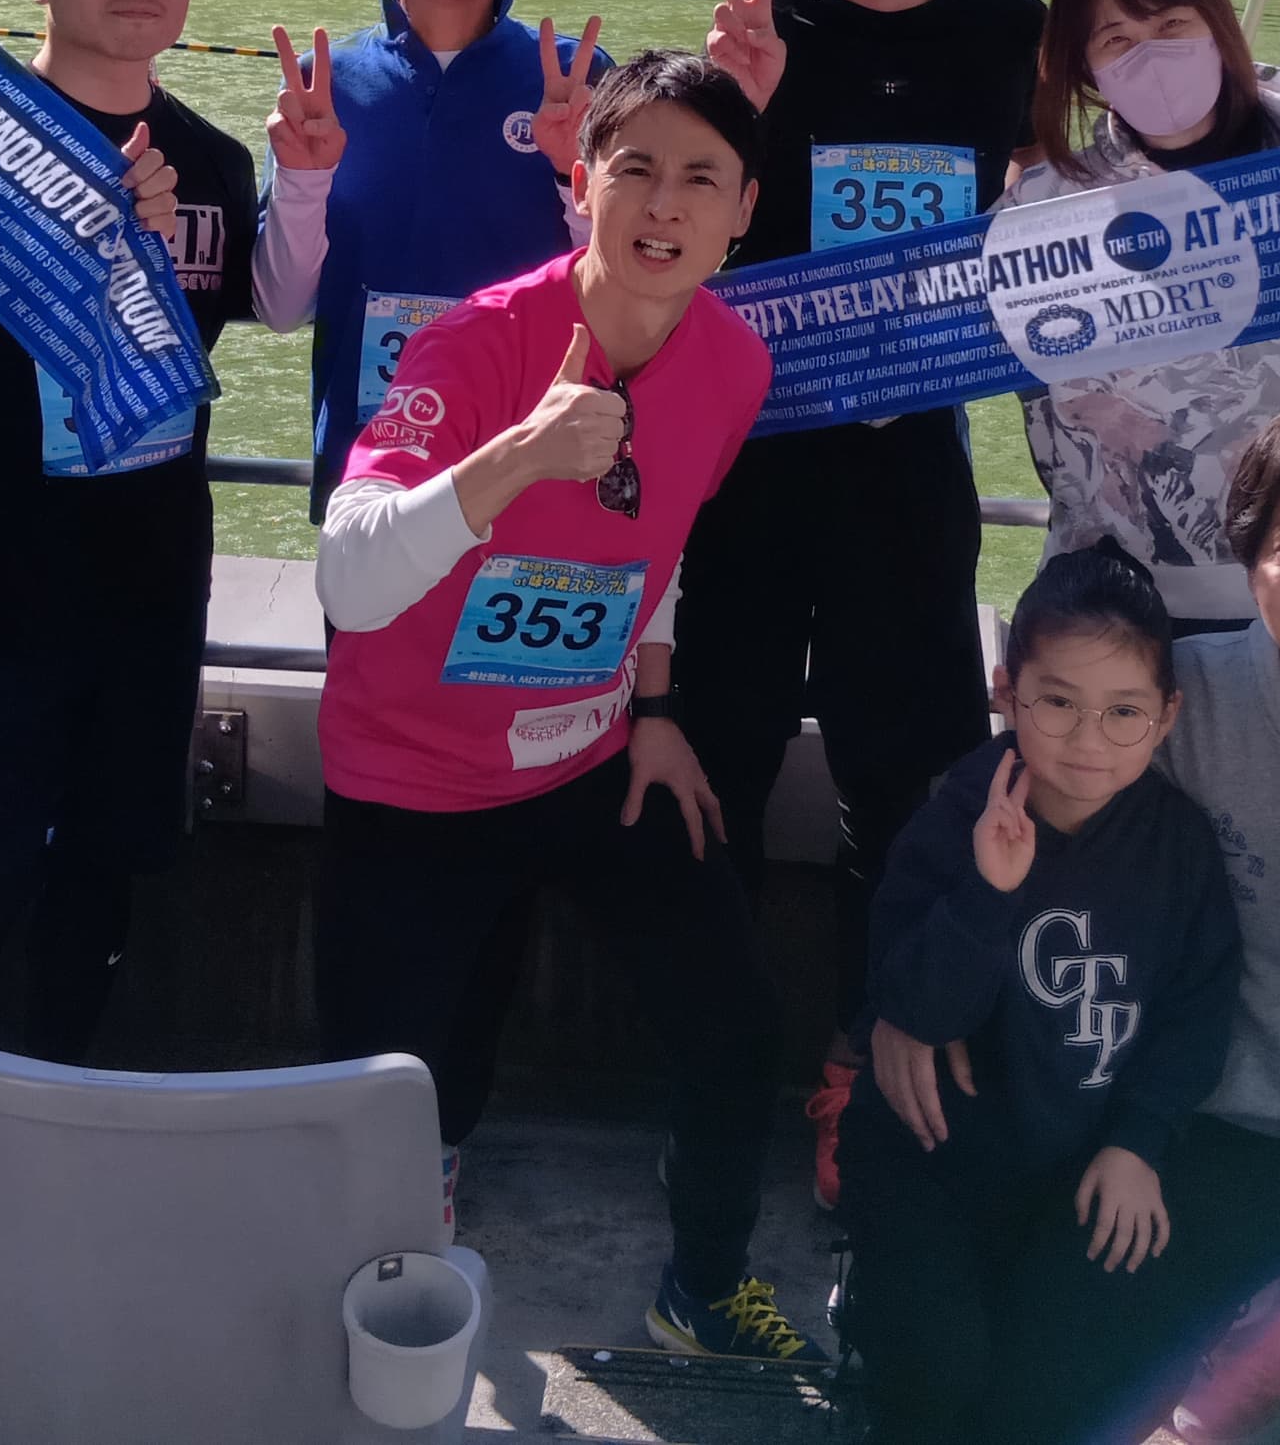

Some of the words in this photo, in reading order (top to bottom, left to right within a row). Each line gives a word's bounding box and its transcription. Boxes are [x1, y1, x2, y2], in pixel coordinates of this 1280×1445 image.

[862, 159, 955, 176] 味の素スタジアム
[831, 178, 945, 232] 353
[1185, 206, 1222, 252] AT
[13, 196, 30, 210] AT
[23, 206, 75, 251] AJINOMOTO
[72, 246, 108, 284] STADIUM
[736, 275, 787, 296] MARATHON
[789, 275, 801, 288] AT
[801, 263, 853, 284] AJINOMOTO
[854, 252, 895, 272] STADIUM
[902, 247, 921, 262] THE
[943, 233, 985, 252] CHARITY
[1107, 237, 1136, 256] THE
[1138, 230, 1166, 249] 5TH
[811, 273, 906, 326] RELAY
[916, 235, 1093, 306] MARATHON
[1005, 288, 1081, 310] SPONSORED
[1083, 284, 1098, 294] BY
[1100, 277, 1136, 292] MDRT
[1138, 269, 1179, 283] JAPAN
[1181, 254, 1242, 274] CHAPTER
[27, 277, 58, 306] RELAY
[50, 300, 97, 349] MARATHON
[781, 330, 833, 351] AJINOMOTO
[835, 321, 876, 341] STADIUM
[884, 319, 902, 331] THE
[903, 314, 921, 328] 5TH
[922, 304, 964, 325] CHARITY
[1114, 324, 1156, 344] JAPAN
[1159, 311, 1222, 334] CHAPTER
[513, 578, 528, 586] at
[528, 574, 627, 596] 味の素スタジアム
[476, 592, 607, 651] 353
